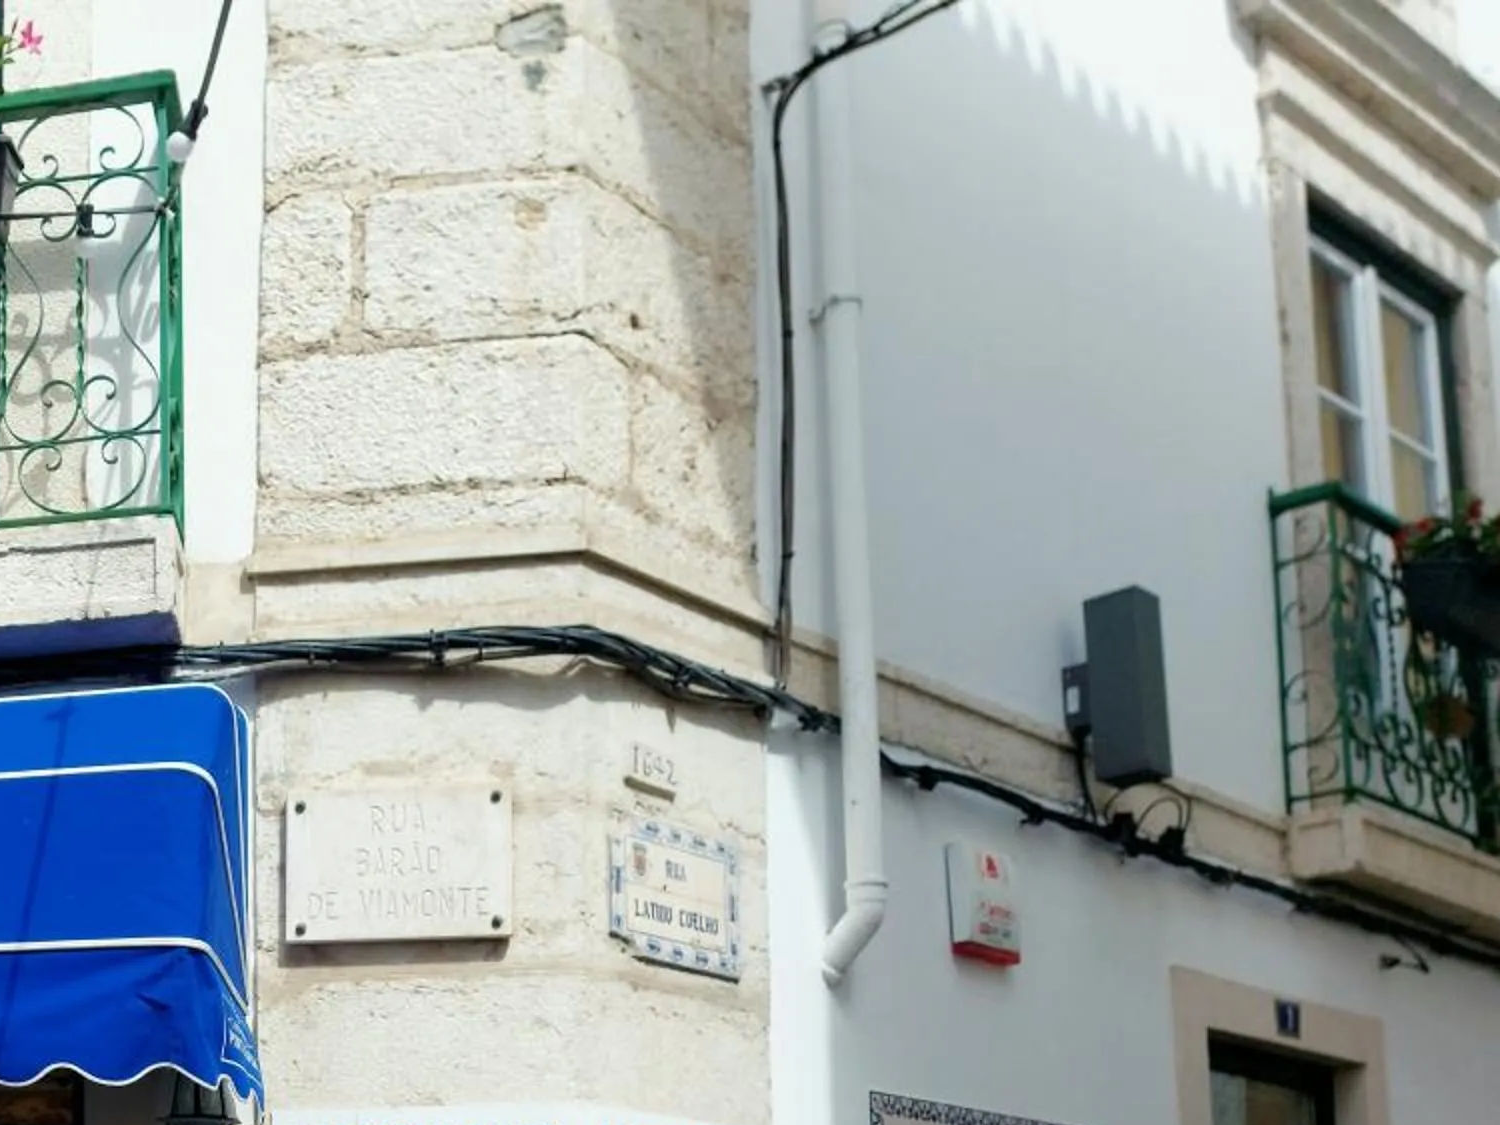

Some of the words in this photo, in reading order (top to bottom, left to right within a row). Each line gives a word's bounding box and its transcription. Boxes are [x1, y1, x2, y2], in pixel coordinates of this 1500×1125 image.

[370, 804, 426, 835] RUA
[356, 841, 441, 876] BARÃO
[307, 891, 338, 920] DE
[358, 887, 491, 919] VIAMONTE
[679, 909, 718, 935] COELHO
